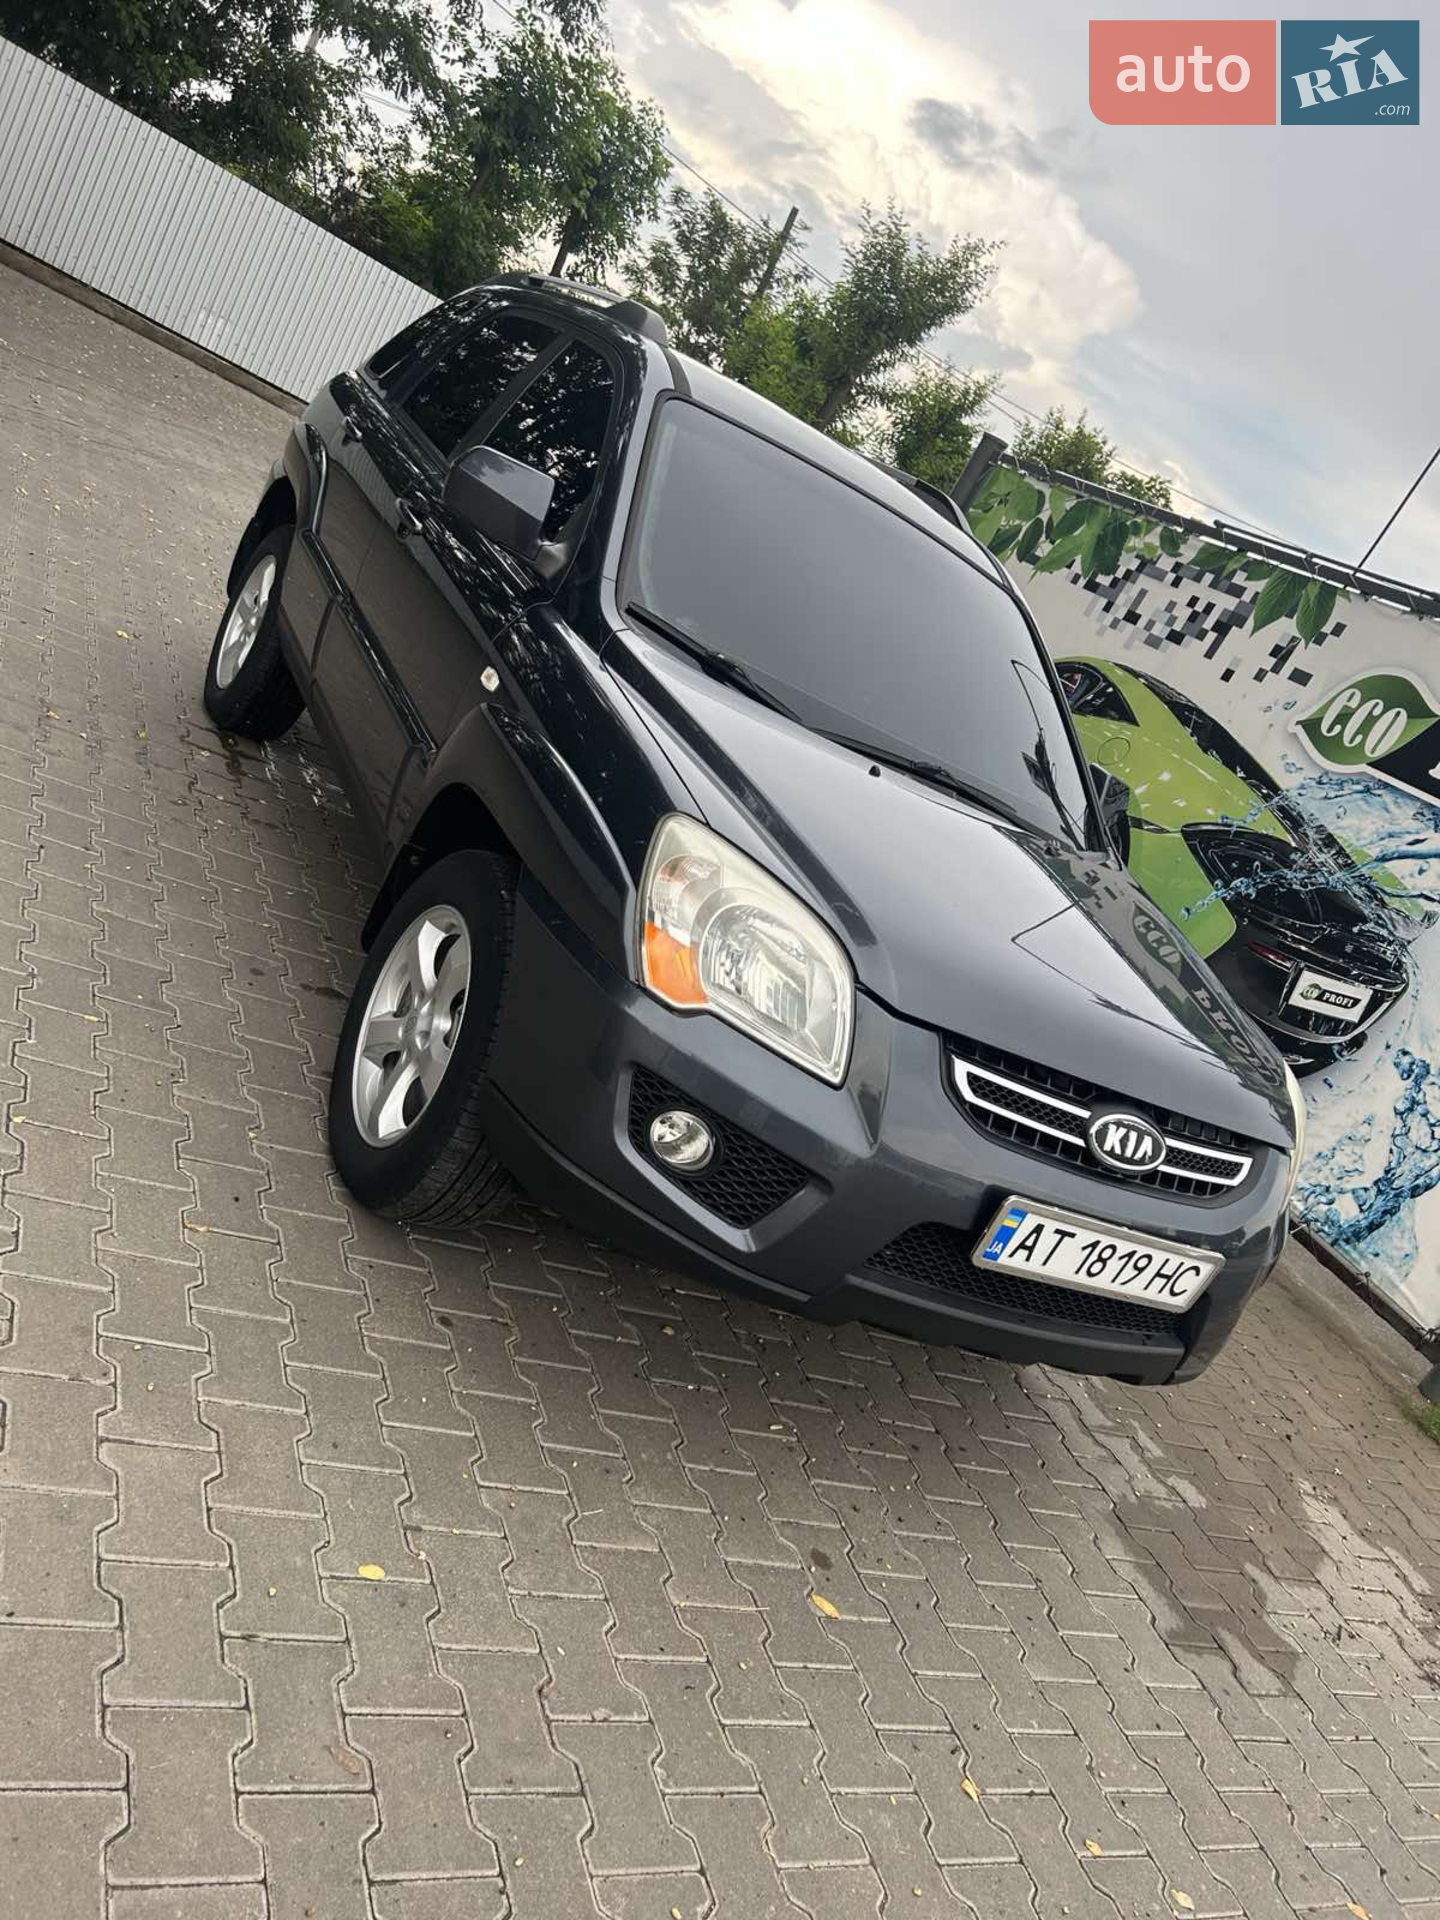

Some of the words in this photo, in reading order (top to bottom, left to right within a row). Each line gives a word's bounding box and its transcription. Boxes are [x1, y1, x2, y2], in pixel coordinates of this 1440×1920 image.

[1320, 688, 1408, 758] eco
[1323, 992, 1354, 1007] PROFI
[1102, 1123, 1153, 1163] KIA
[1008, 1223, 1077, 1266] AT
[1075, 1240, 1153, 1286] 1819
[1143, 1258, 1200, 1297] HC
